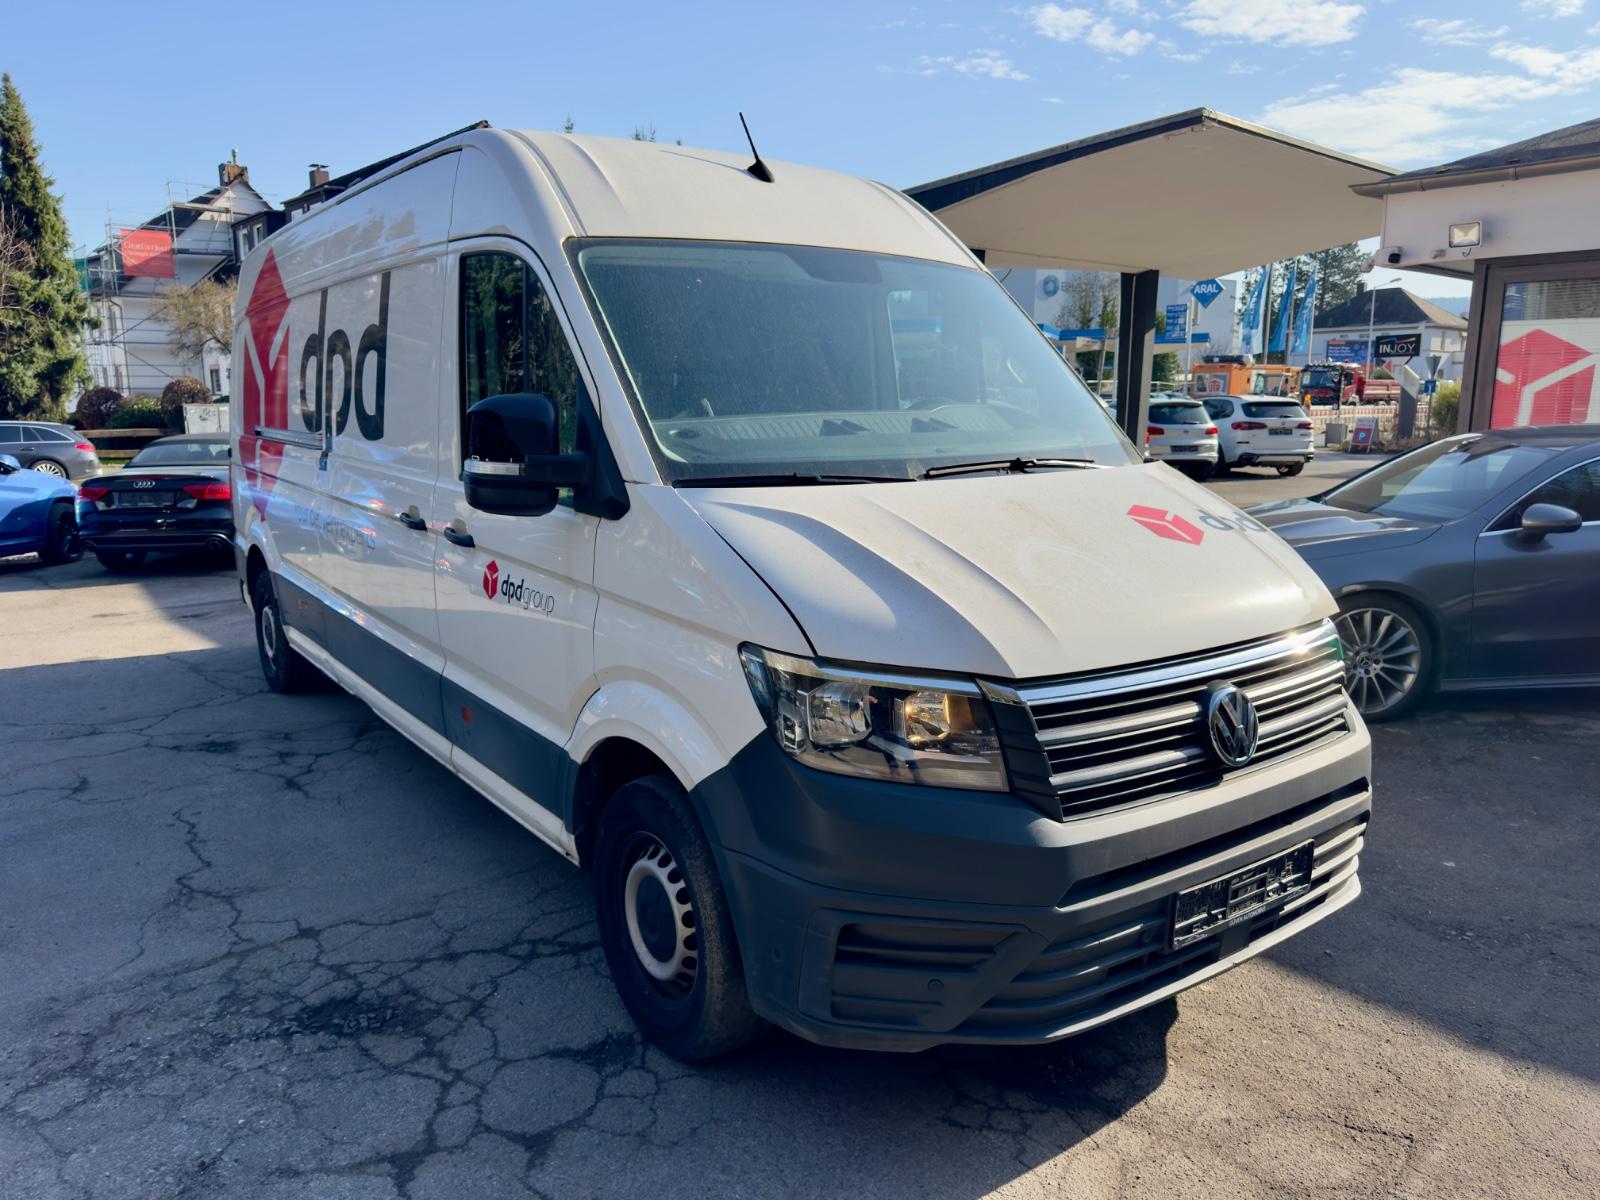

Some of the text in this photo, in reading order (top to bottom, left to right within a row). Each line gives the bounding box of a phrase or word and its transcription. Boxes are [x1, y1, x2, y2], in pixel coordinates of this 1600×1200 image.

[1194, 283, 1219, 294] ARAL
[1379, 343, 1416, 354] INJOY
[300, 271, 391, 468] dpd
[501, 573, 555, 616] dpdgroup
